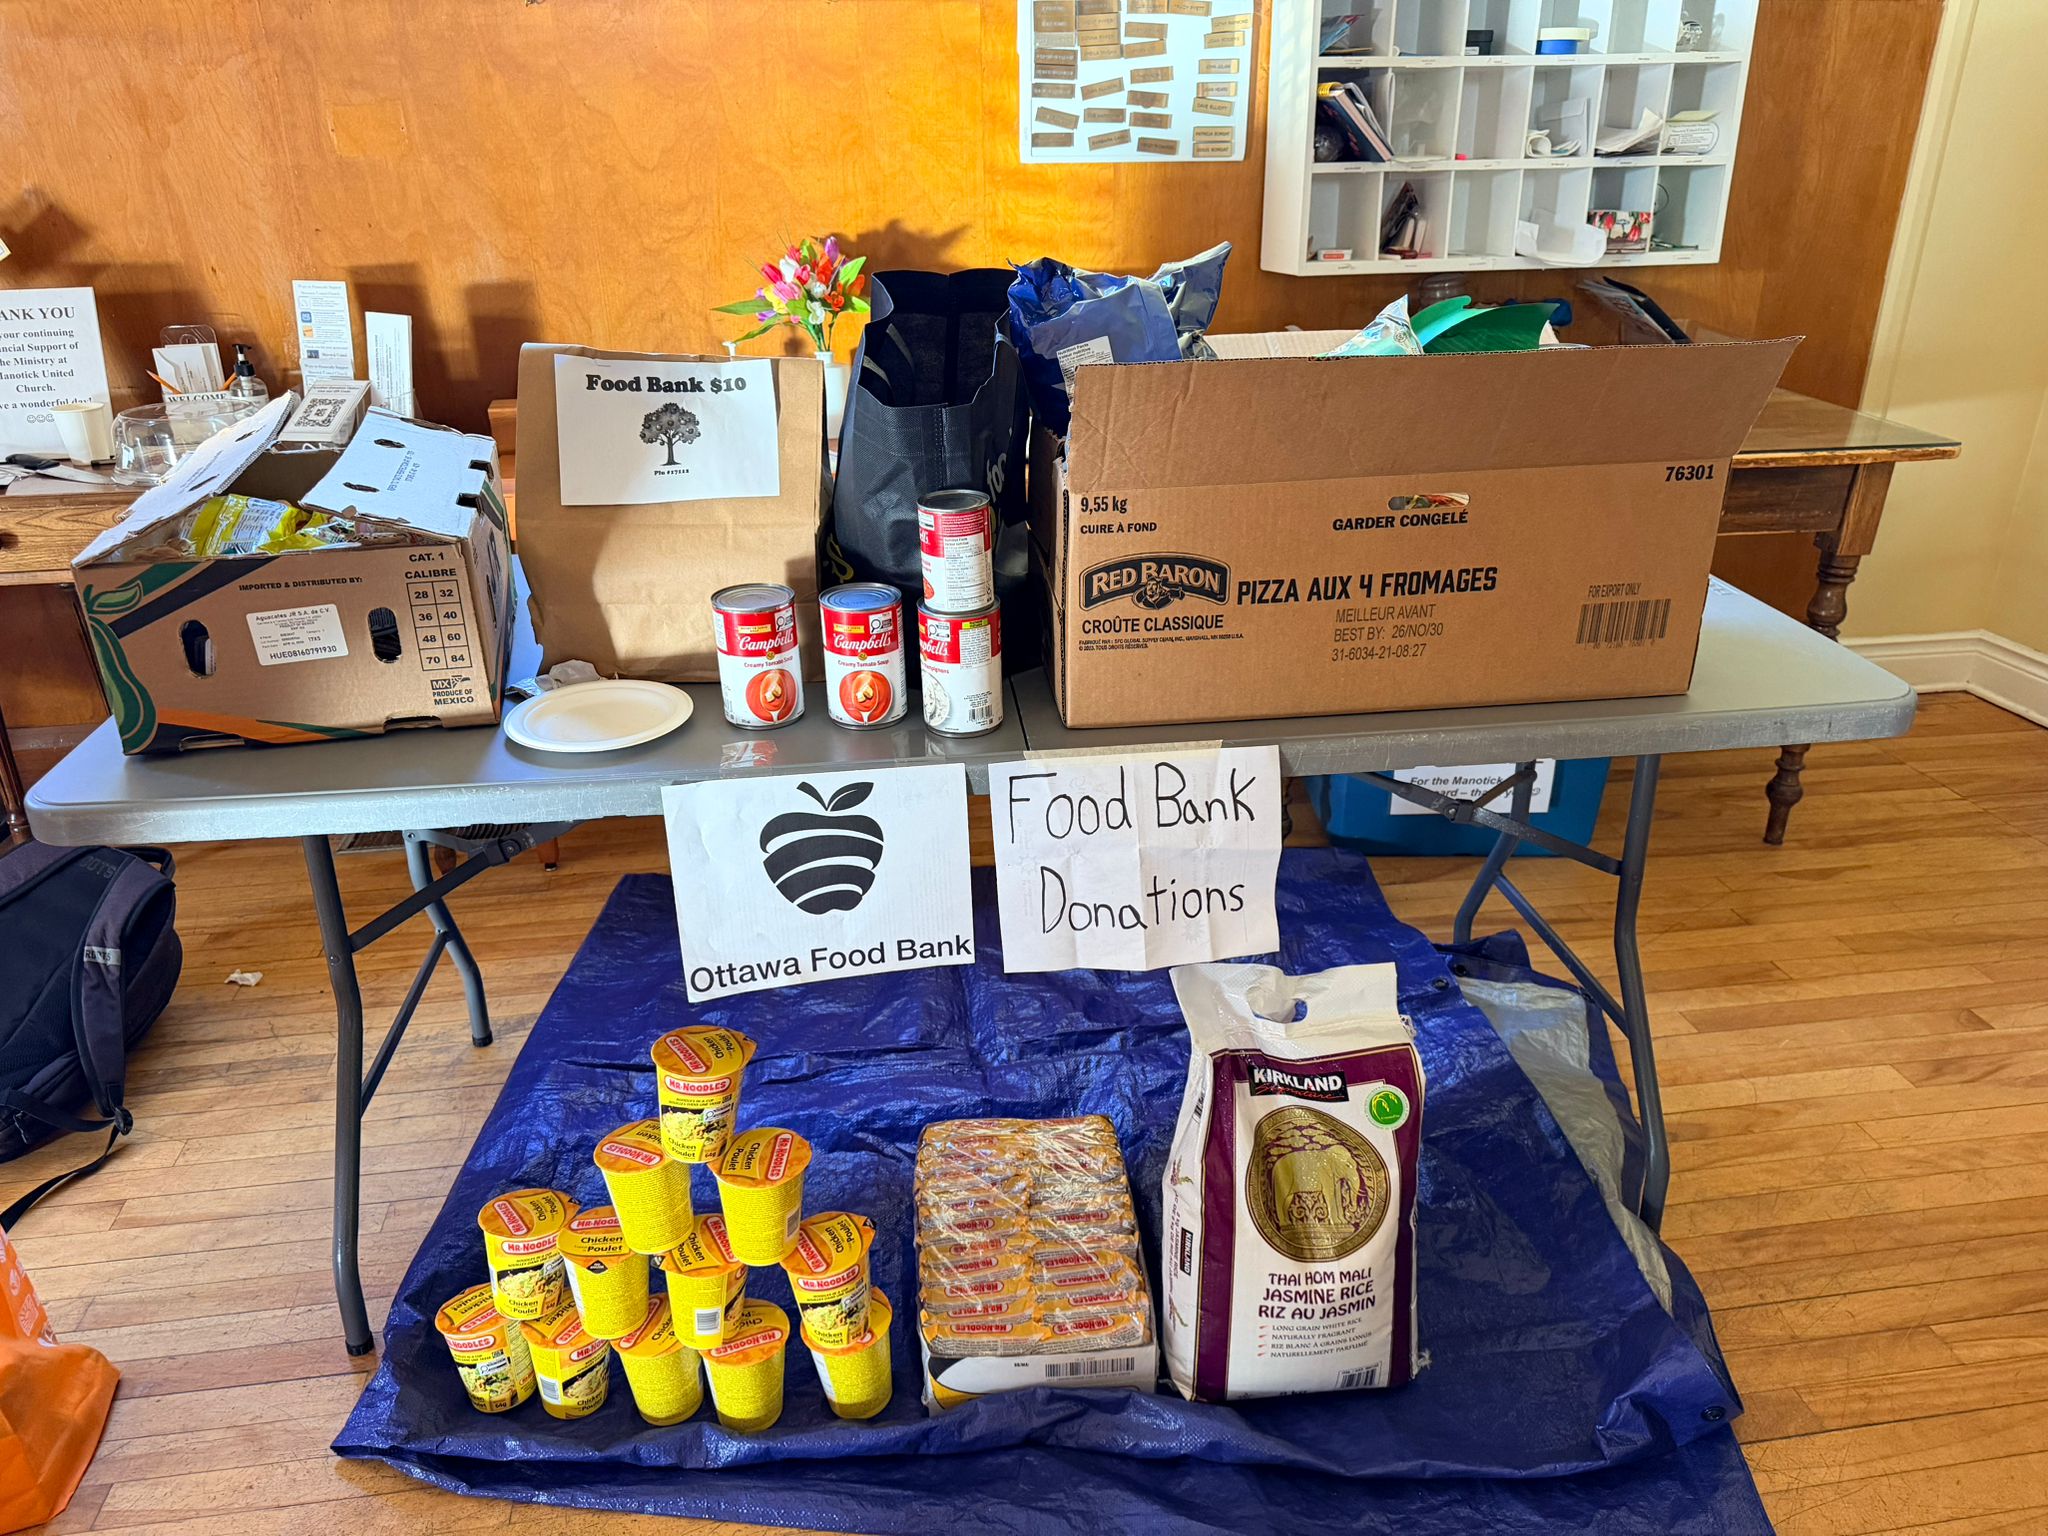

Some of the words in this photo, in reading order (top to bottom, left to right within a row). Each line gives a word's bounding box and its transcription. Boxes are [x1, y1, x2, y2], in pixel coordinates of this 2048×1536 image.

[38, 307, 75, 319] YOU
[23, 329, 74, 340] continuing
[27, 343, 67, 353] Support
[69, 342, 79, 350] of
[14, 357, 55, 367] Ministry
[58, 356, 67, 364] at
[42, 369, 74, 378] United
[16, 384, 56, 393] Church.
[586, 374, 642, 392] Food
[647, 377, 705, 393] Bank
[710, 377, 747, 394] $10
[168, 393, 226, 403] WELCOME
[1664, 464, 1715, 482] 76301
[1080, 496, 1109, 515] 9,55
[1113, 496, 1128, 514] kg
[1080, 523, 1115, 534] CUIRE
[1117, 520, 1125, 533] À
[1127, 522, 1157, 533] FOND
[1332, 515, 1395, 532] GARDER
[1399, 508, 1469, 527] CONGELÉ
[409, 553, 434, 562] CAT.
[438, 552, 444, 560] 1
[404, 568, 457, 579] CALIBRE
[1091, 568, 1137, 597] RED
[1141, 561, 1223, 594] BARON
[239, 582, 282, 591] IMPORTED
[292, 577, 347, 588] DISTRIBUTED
[1237, 578, 1300, 605] PIZZA
[1307, 575, 1352, 602] AUX
[1359, 574, 1372, 598] 4
[1380, 566, 1498, 597] FROMAGES
[1588, 585, 1600, 598] FOR
[1601, 583, 1625, 597] EXPORT
[1625, 582, 1642, 596] ONLY
[414, 591, 429, 599] 28
[439, 589, 454, 597] 32
[418, 613, 433, 621] 36
[443, 611, 457, 619] 40
[1335, 605, 1395, 623] MEILLEUR
[1396, 603, 1436, 619] AVANT
[1082, 614, 1140, 634] CROÛTE
[1144, 615, 1224, 633] CLASSIQUE
[1333, 627, 1365, 642] BEST
[1366, 626, 1385, 641] BY:
[1391, 622, 1443, 639] 26/NO/30
[422, 635, 437, 643] 48
[447, 632, 461, 641] 60
[736, 629, 794, 652] Campbell's
[833, 632, 891, 652] Campbell's
[426, 656, 441, 664] 70
[451, 654, 465, 662] 84
[1331, 643, 1427, 662] 31-6034-21-08:27
[765, 659, 783, 667] Tomato
[432, 680, 450, 689] MX
[432, 689, 463, 697] PRODUCE
[434, 696, 474, 705] MEXICO
[1410, 777, 1429, 786] For
[1432, 776, 1449, 786] the
[1452, 776, 1503, 785] Manotick
[1009, 766, 1132, 843] Food
[1155, 762, 1256, 828] Bank
[1040, 866, 1245, 934] Donations
[690, 956, 801, 993] Ottawa
[810, 942, 886, 972] Food
[896, 935, 972, 961] Bank
[704, 1037, 724, 1059] Chicken
[1254, 1068, 1342, 1091] KIRKLAND
[668, 1137, 697, 1150] Chicken
[672, 1146, 695, 1158] Poulet
[728, 1148, 744, 1171] Poulet
[744, 1142, 760, 1170] Chicken
[530, 1200, 547, 1221] Chicken
[688, 1232, 705, 1261] Chicken
[825, 1227, 844, 1254] Chicken
[1269, 1273, 1301, 1286] THAI
[1305, 1271, 1335, 1285] HOM
[1340, 1267, 1372, 1283] MALI
[1263, 1288, 1335, 1304] JASMINE
[1341, 1280, 1374, 1300] RICE
[451, 1292, 486, 1313] Poulet
[460, 1295, 494, 1314] hicken
[1258, 1305, 1286, 1319] RIZ
[1291, 1308, 1315, 1320] AU
[1319, 1295, 1376, 1320] JASMIN
[1322, 1321, 1345, 1330] WHITE
[1347, 1317, 1362, 1326] RICE
[814, 1328, 842, 1338] Chicken
[1285, 1341, 1310, 1349] BLANC
[1320, 1337, 1347, 1347] GRAINS
[1349, 1331, 1372, 1342] LONGS
[1318, 1328, 1355, 1339] FRAGRANT
[1270, 1348, 1334, 1358] NATURELLEMENT
[1335, 1341, 1368, 1353] PARFUMÉ
